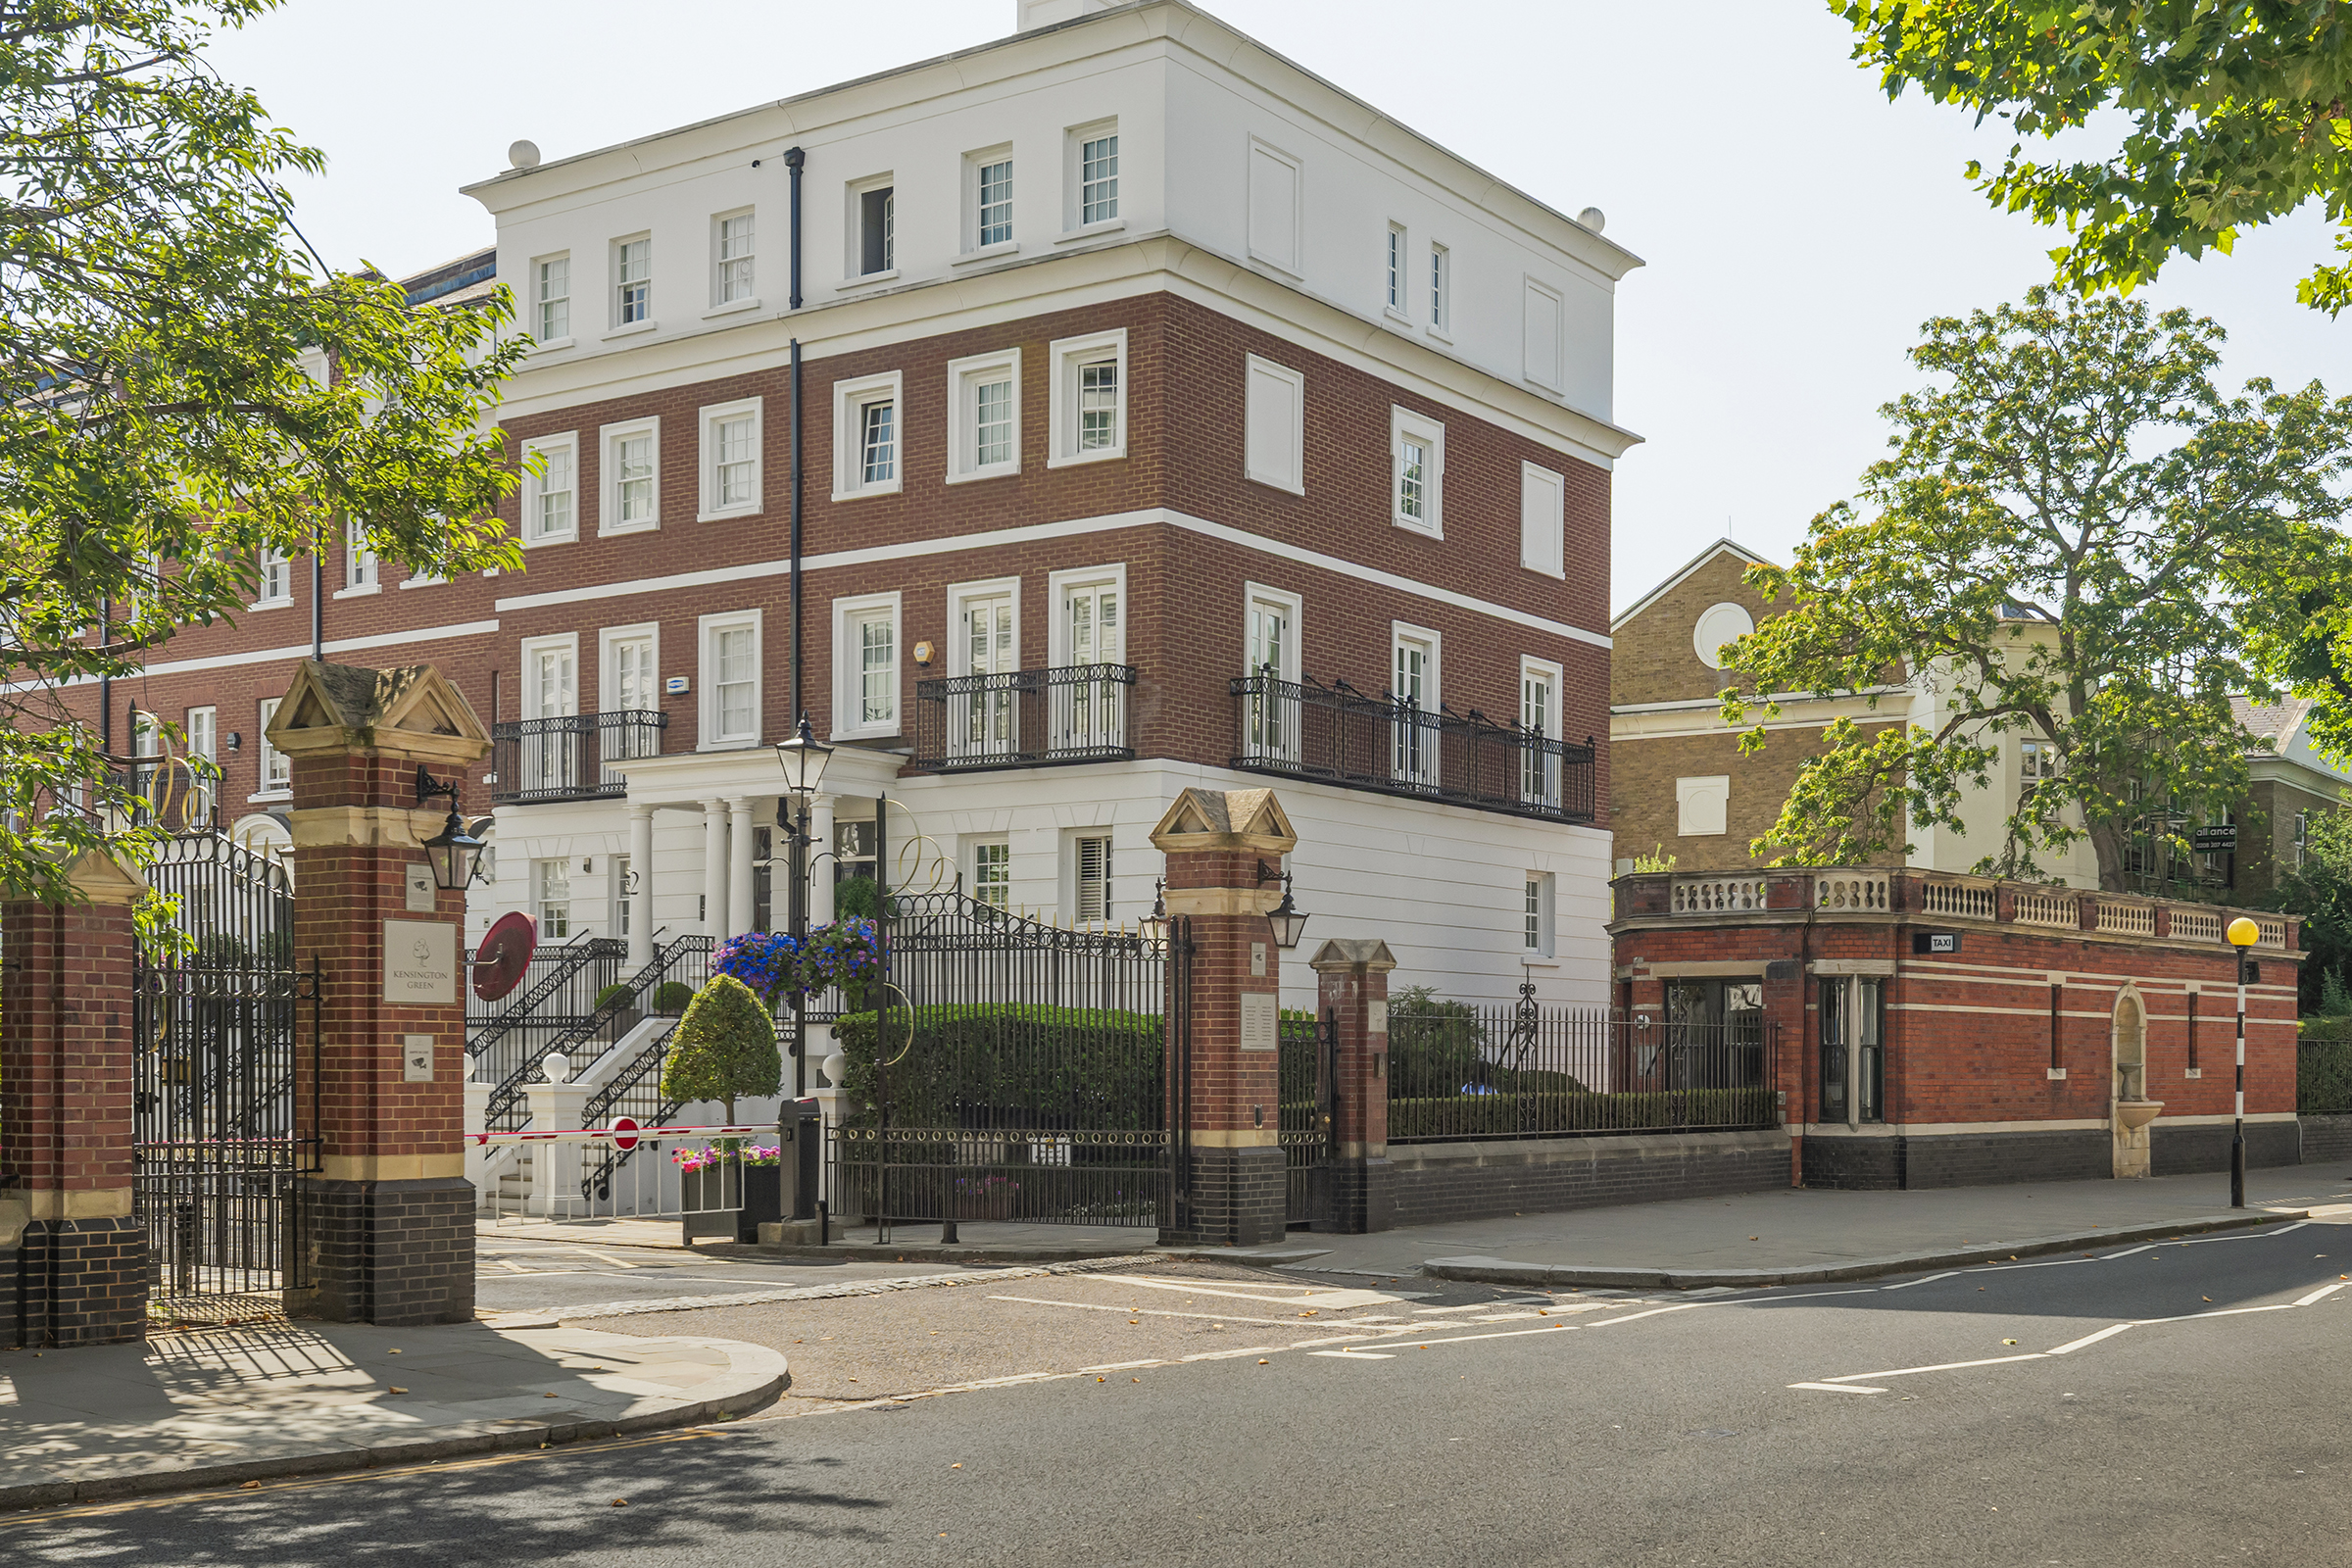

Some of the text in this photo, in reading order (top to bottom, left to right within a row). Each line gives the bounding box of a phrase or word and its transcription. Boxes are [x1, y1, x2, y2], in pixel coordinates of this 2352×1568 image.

[630, 871, 639, 895] 2
[393, 970, 448, 980] KENSINGTON
[407, 981, 434, 990] GREEN
